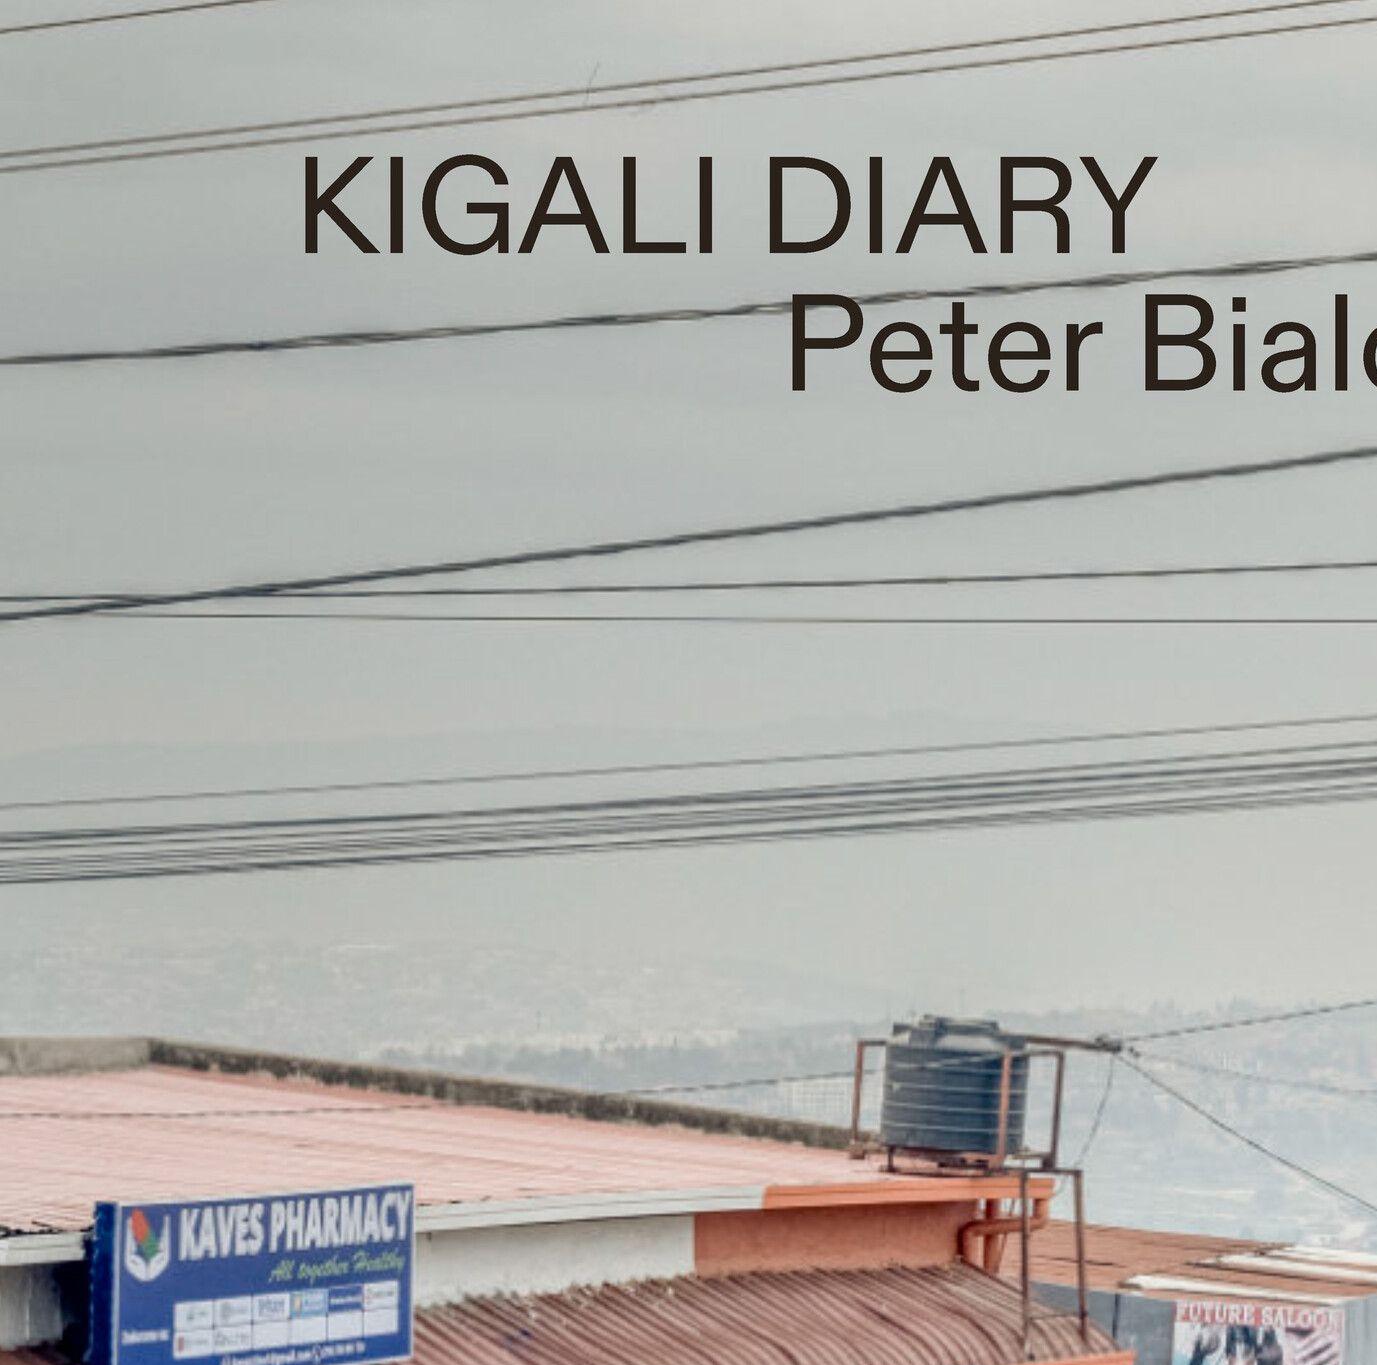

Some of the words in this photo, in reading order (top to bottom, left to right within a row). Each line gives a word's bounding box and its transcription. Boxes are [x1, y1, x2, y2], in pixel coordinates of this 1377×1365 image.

[178, 1203, 265, 1261] KAVES
[269, 1190, 412, 1253] PHARMACY
[1175, 1301, 1256, 1324] FUTURE
[1261, 1305, 1339, 1331] SALOON
